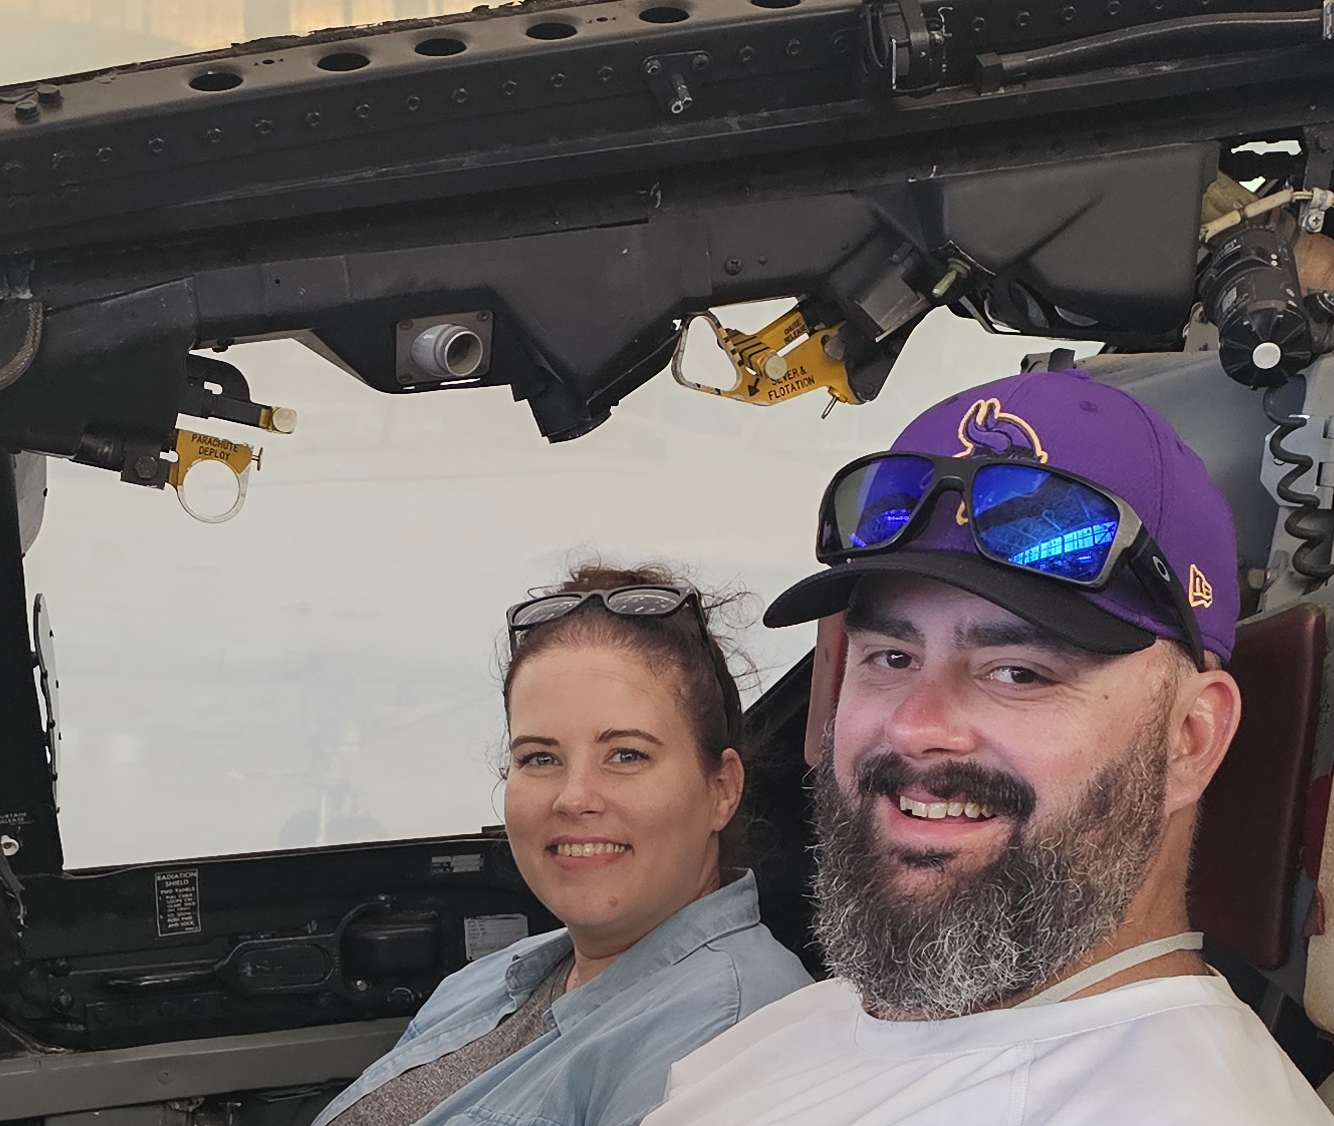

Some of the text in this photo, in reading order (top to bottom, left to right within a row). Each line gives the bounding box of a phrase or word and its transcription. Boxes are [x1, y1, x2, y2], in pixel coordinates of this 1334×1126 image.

[767, 375, 816, 401] FLOTATION
[191, 434, 239, 453] PARACHUTE
[198, 446, 231, 460] DEPLOY
[157, 872, 197, 880] RADIATION
[165, 879, 189, 887] SHIELD
